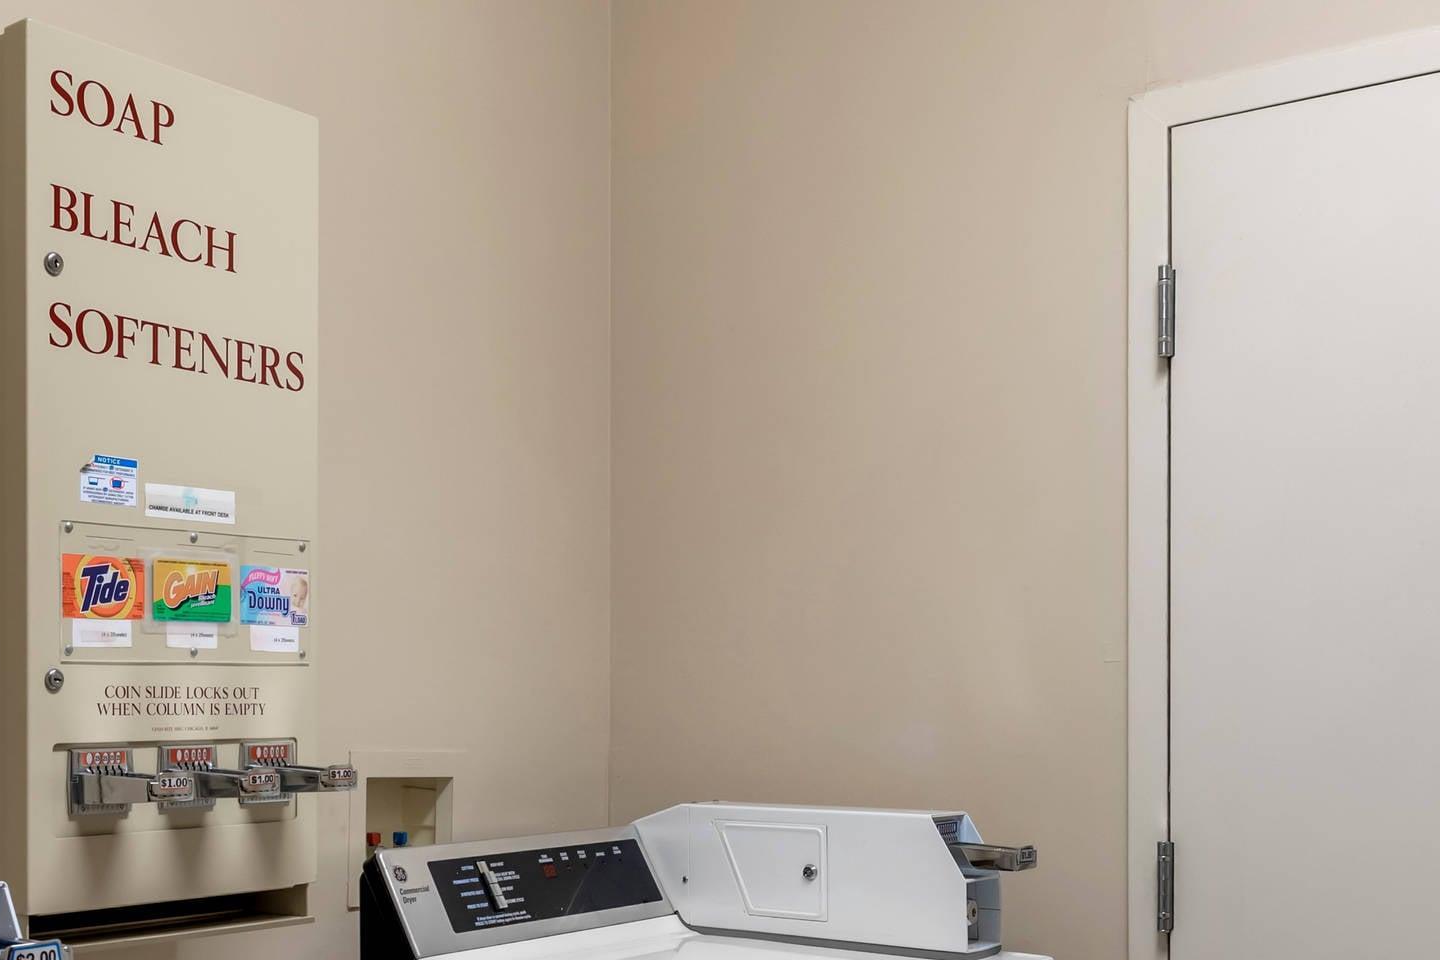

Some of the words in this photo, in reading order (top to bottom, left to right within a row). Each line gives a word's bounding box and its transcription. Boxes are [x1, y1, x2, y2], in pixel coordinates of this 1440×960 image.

[50, 70, 175, 146] SOAP
[50, 184, 237, 273] BLEACH
[48, 302, 305, 392] SOFTENERS
[97, 457, 120, 465] NOTICE
[148, 504, 168, 512] CHANGE
[169, 507, 194, 515] AVAILABLE
[81, 563, 130, 613] Tide
[163, 570, 218, 609] GAIN
[257, 586, 280, 595] ULTRA
[248, 591, 289, 616] Downy
[104, 685, 141, 699] COIN
[145, 685, 181, 699] SLIDE
[186, 686, 229, 700] LOCKS
[232, 686, 260, 700] OUT
[96, 702, 141, 716] WHEN
[146, 702, 205, 716] COLUMN
[210, 703, 220, 716] IS
[224, 703, 266, 716] EMPTY
[251, 774, 274, 784] $1.00
[330, 770, 352, 779] $1.00
[161, 777, 188, 789] $1.00
